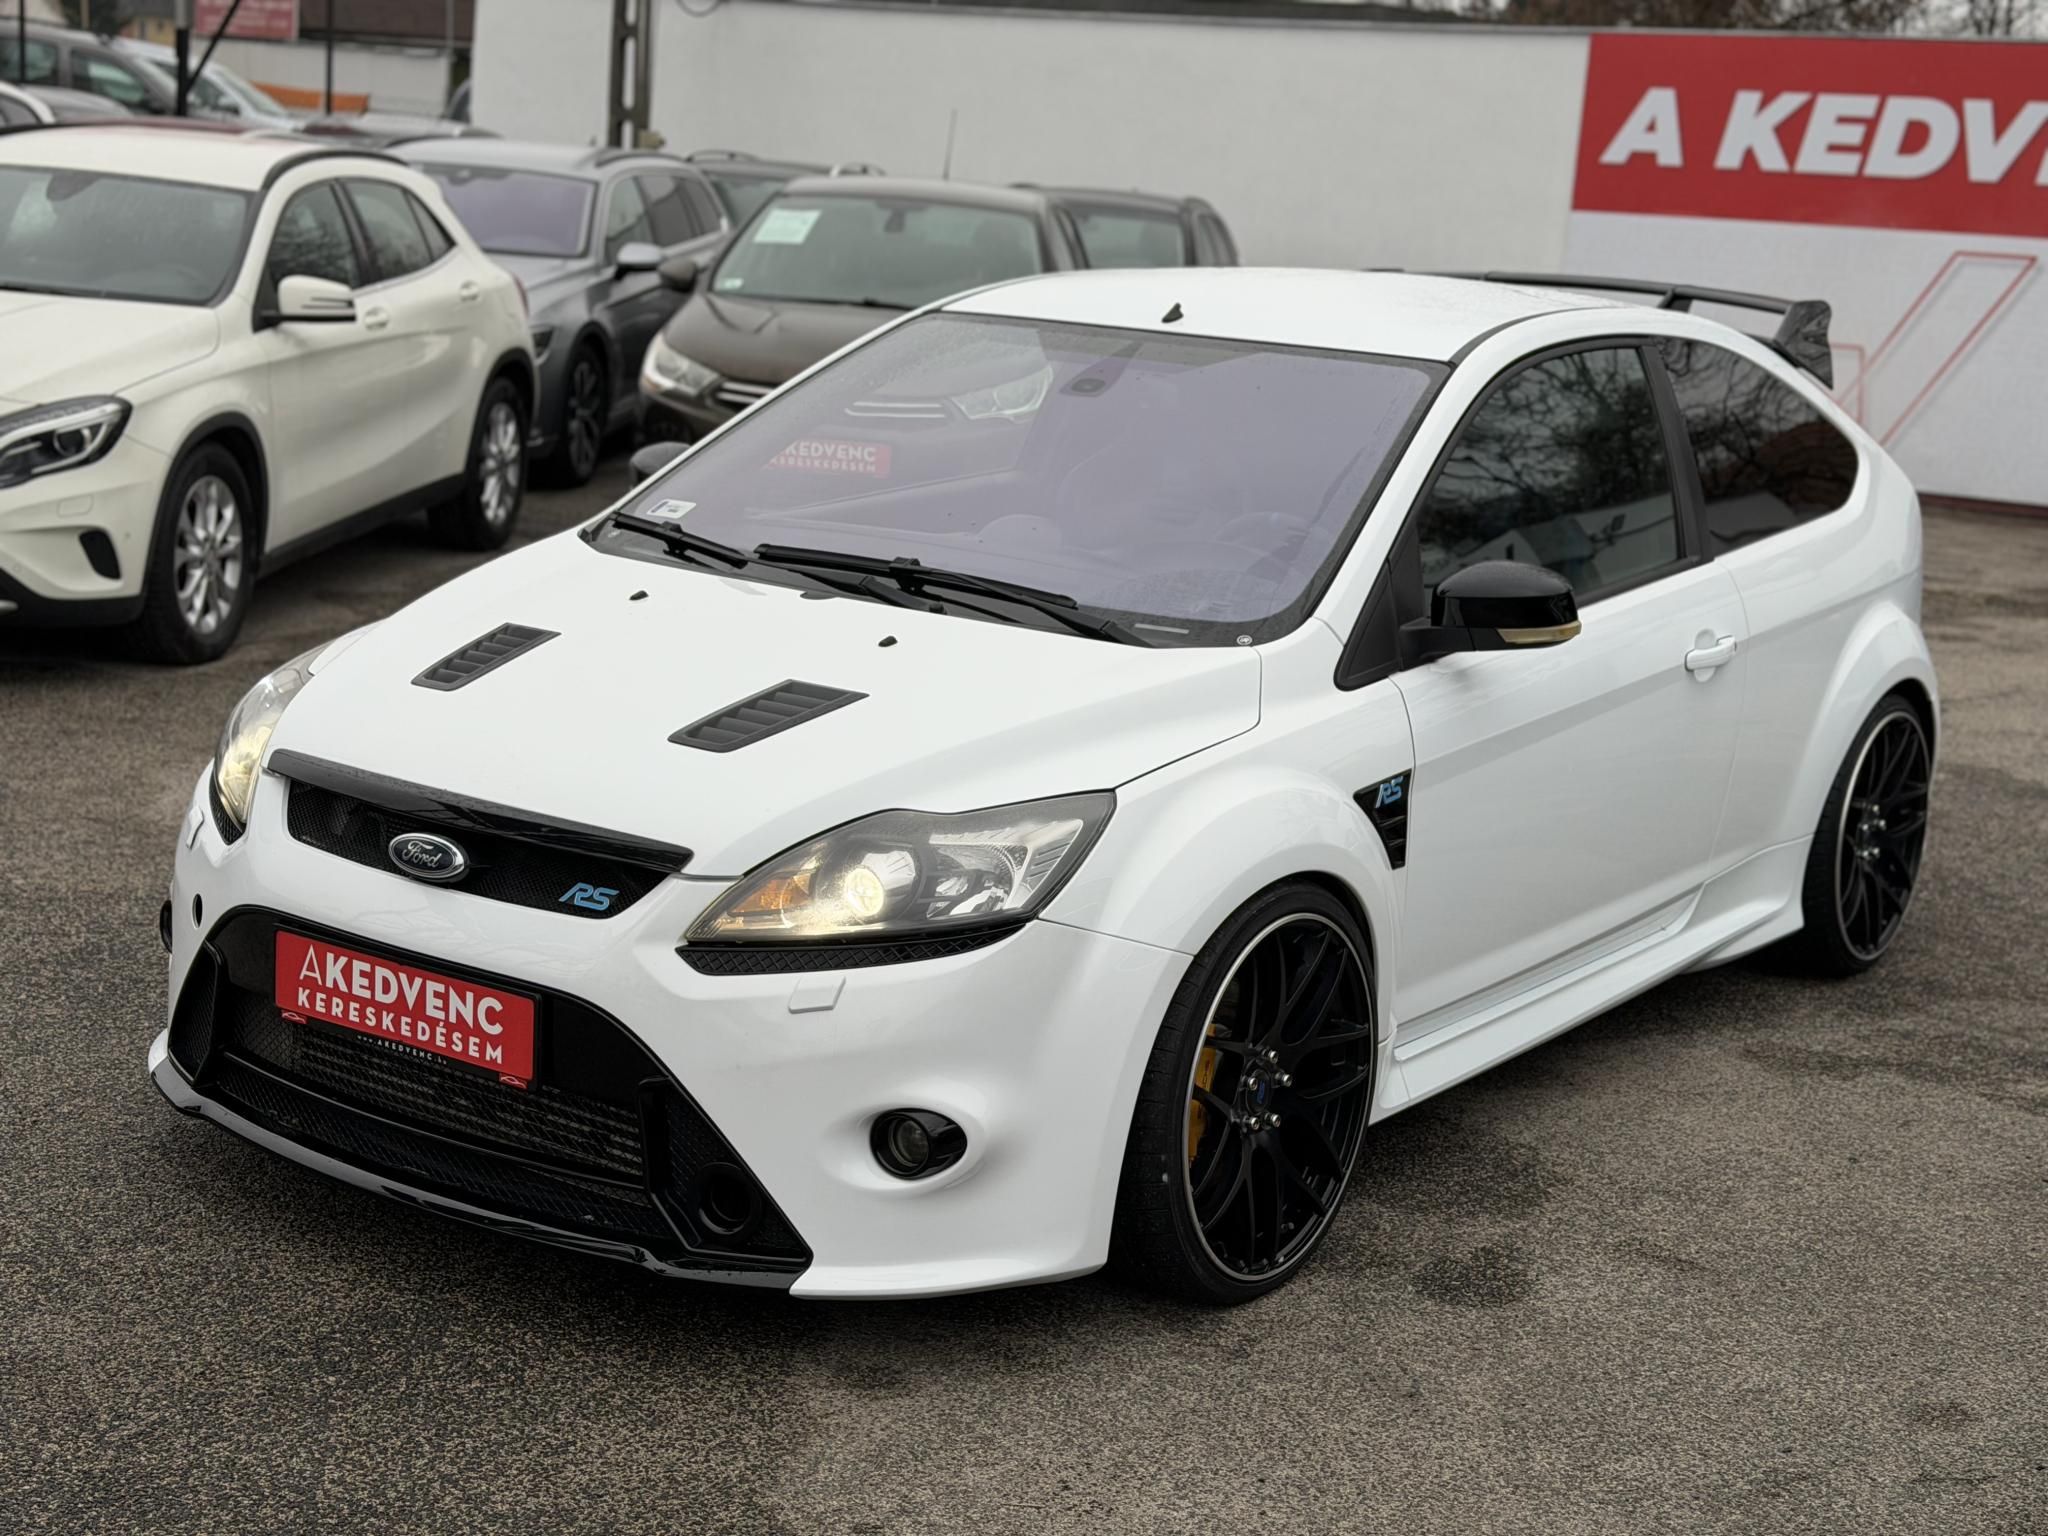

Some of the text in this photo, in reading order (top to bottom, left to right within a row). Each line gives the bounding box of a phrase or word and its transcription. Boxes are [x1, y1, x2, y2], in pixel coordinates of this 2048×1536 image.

[1599, 87, 2048, 187] A KEDV
[1375, 776, 1404, 808] RS
[401, 840, 442, 868] Ford
[558, 882, 620, 911] RS
[297, 986, 503, 1065] KERESKEDÉSEM
